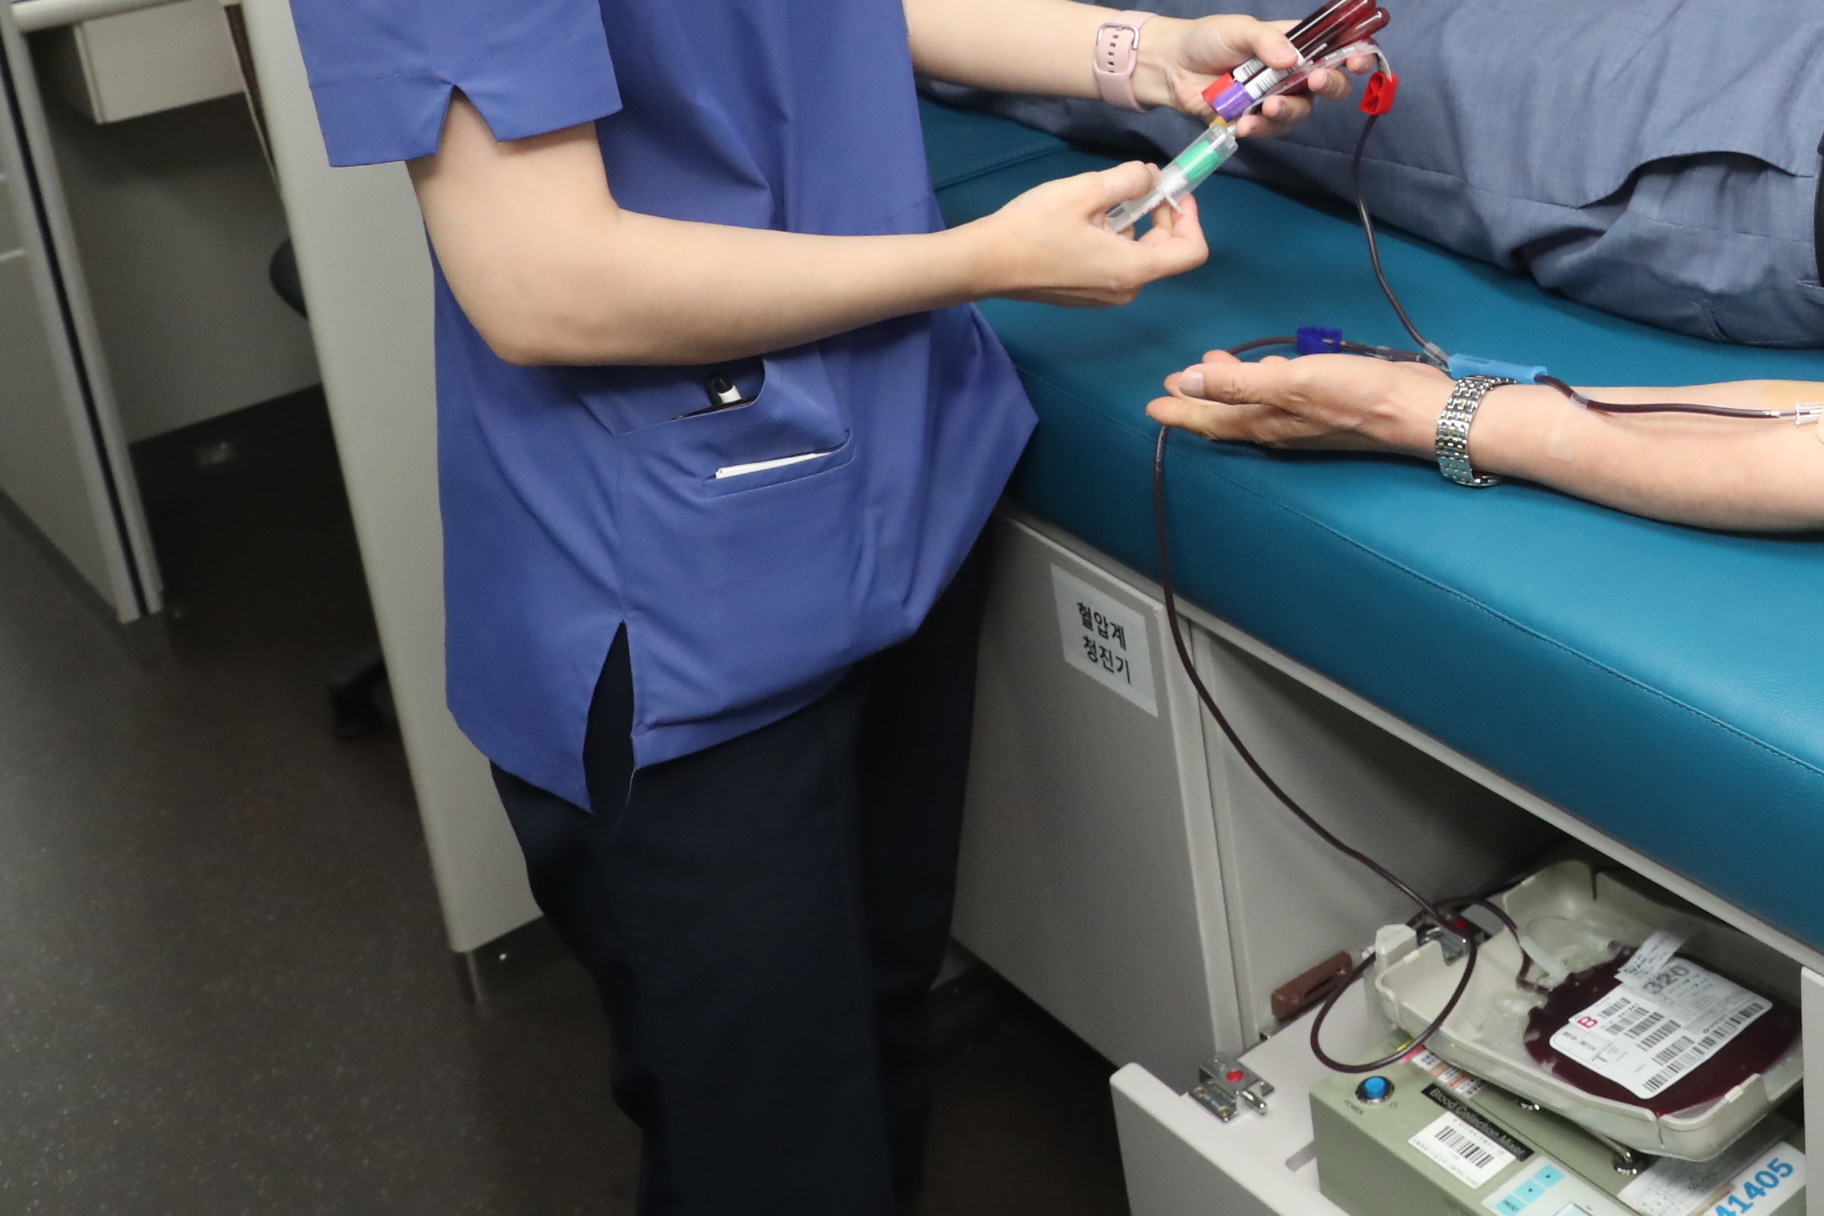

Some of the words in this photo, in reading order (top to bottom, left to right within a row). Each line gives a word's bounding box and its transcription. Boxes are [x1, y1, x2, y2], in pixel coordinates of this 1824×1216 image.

[1077, 602, 1127, 651] 혈압계
[1082, 635, 1131, 684] 청진기
[1577, 1016, 1598, 1029] B
